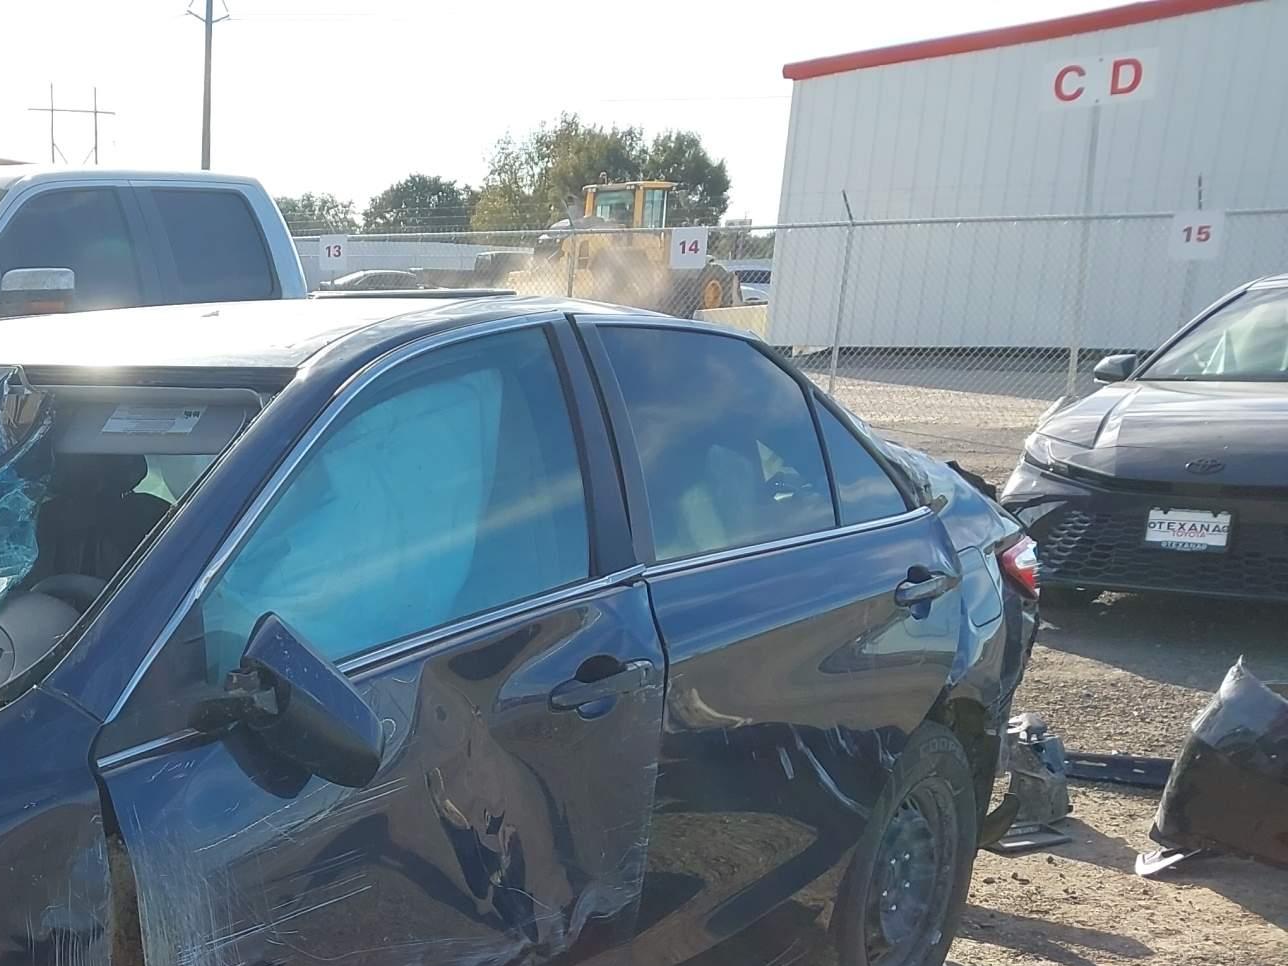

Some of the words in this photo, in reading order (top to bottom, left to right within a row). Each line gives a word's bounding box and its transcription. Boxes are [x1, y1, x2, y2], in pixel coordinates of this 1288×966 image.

[1054, 64, 1086, 102] C
[1110, 58, 1143, 96] D
[1182, 225, 1212, 243] 15
[325, 244, 342, 258] 13
[679, 239, 700, 255] 14
